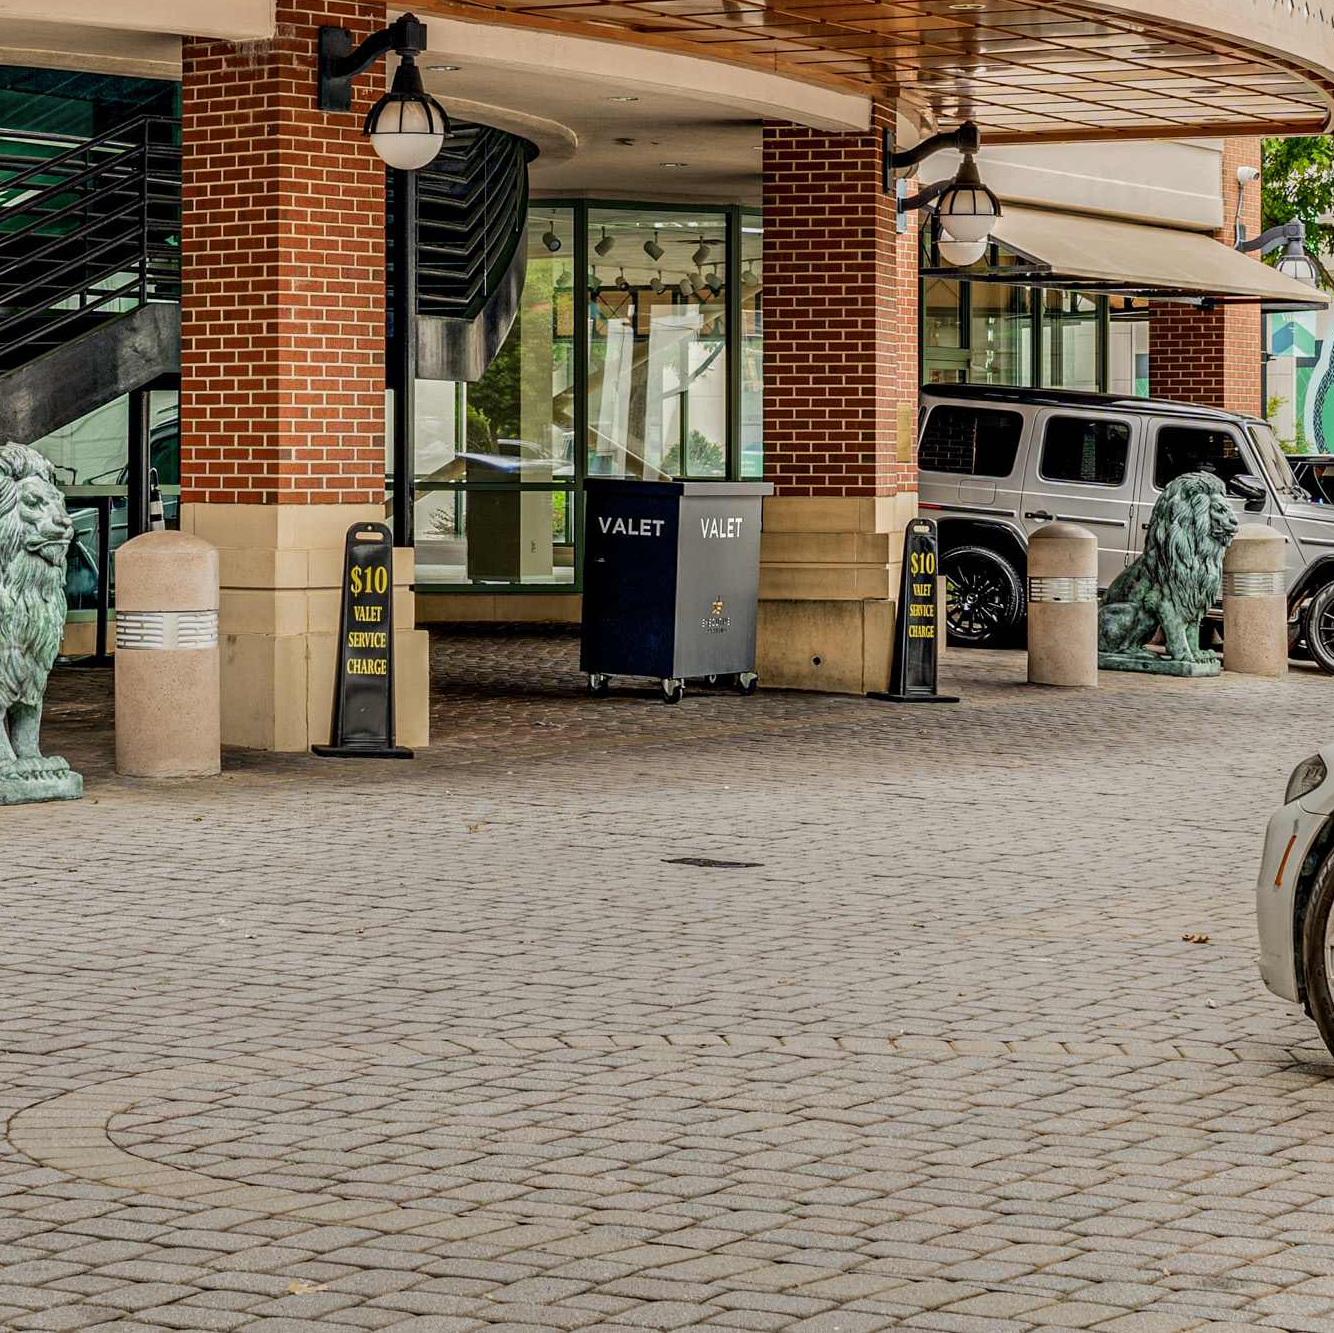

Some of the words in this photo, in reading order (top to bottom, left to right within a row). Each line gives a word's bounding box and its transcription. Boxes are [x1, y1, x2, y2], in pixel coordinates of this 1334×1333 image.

[598, 517, 665, 537] VALET
[700, 518, 743, 539] VALET
[910, 551, 935, 577] $10
[350, 565, 387, 597] $10
[913, 583, 932, 596] VALET
[353, 605, 382, 622] VALET
[909, 604, 934, 617] SERVICE
[348, 632, 387, 648] SERVICE
[908, 625, 935, 638] CHARGE
[347, 658, 387, 675] CHARGE
